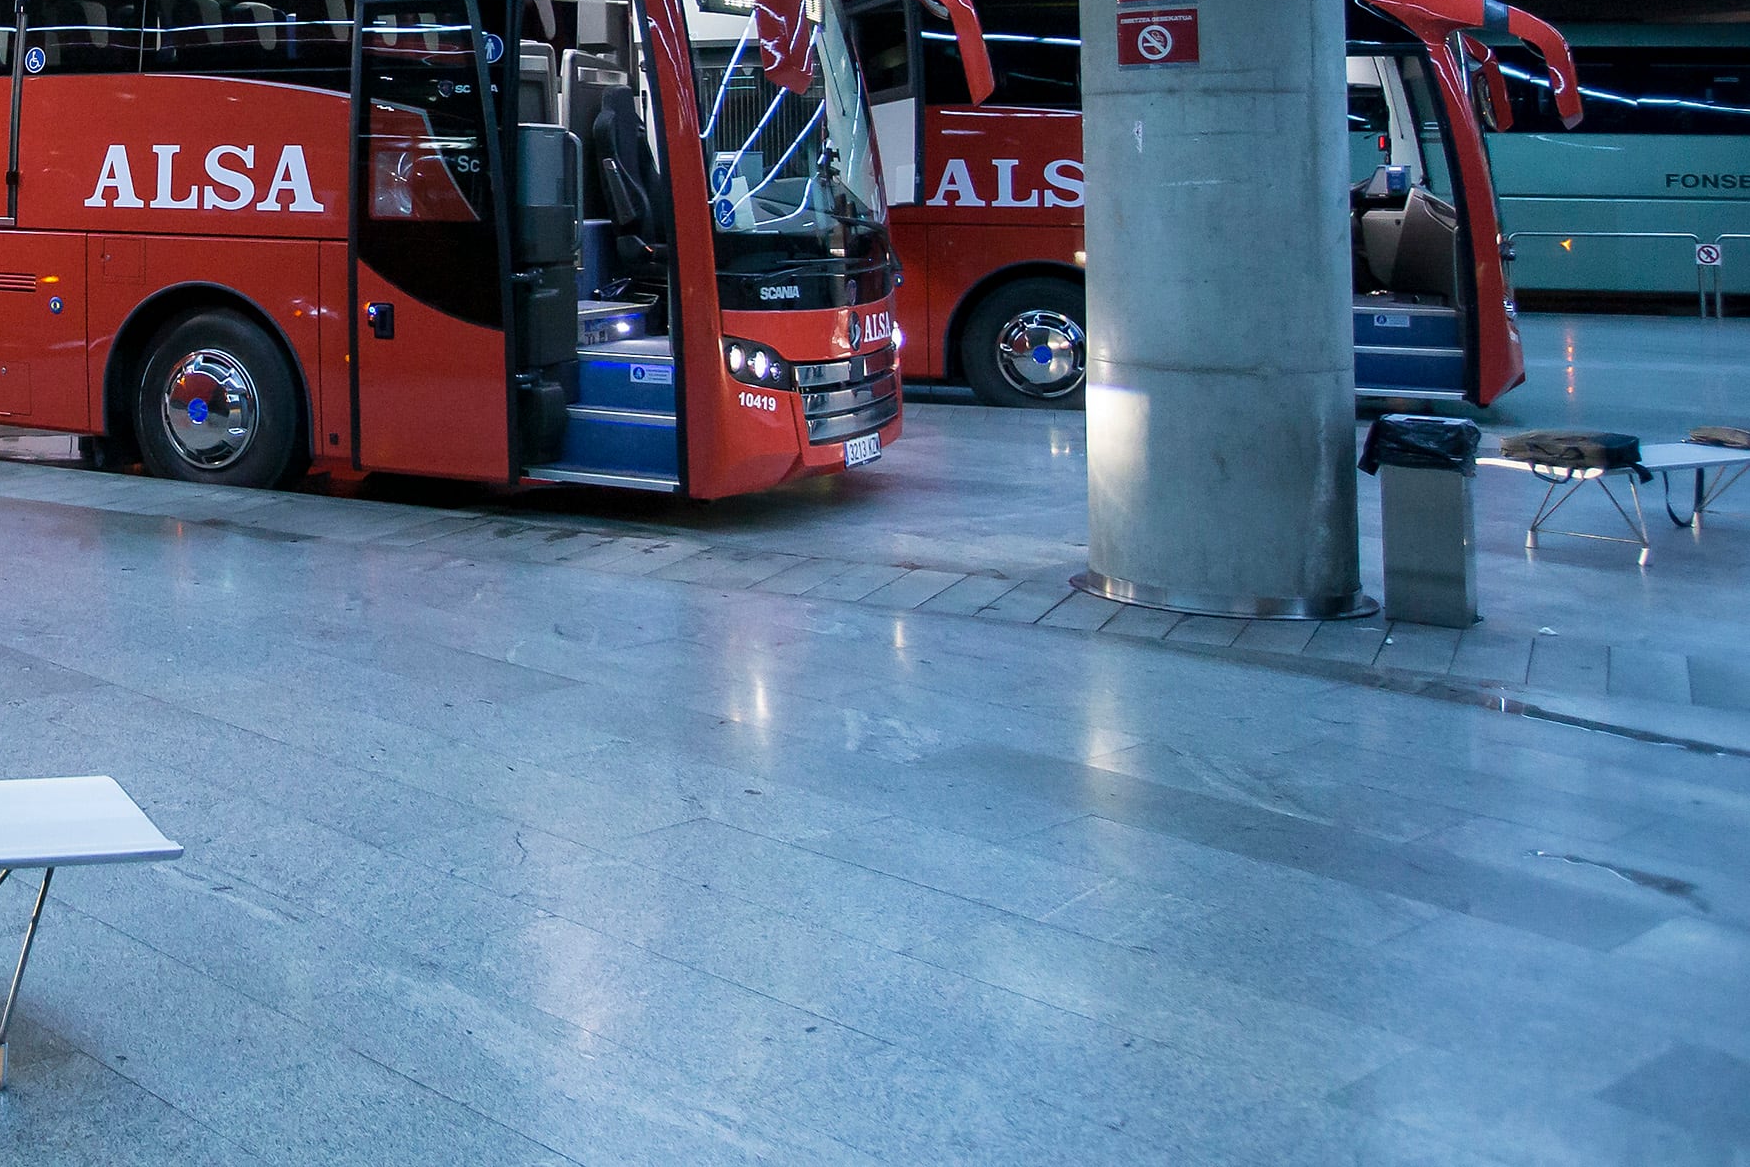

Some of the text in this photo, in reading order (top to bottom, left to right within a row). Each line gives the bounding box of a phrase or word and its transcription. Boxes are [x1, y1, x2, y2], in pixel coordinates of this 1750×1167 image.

[84, 144, 324, 212] ALSA
[926, 159, 1085, 208] ALS
[760, 285, 800, 300] SCANIA
[863, 311, 892, 342] ALSA
[738, 391, 777, 411] 10419
[849, 440, 867, 461] 3213
